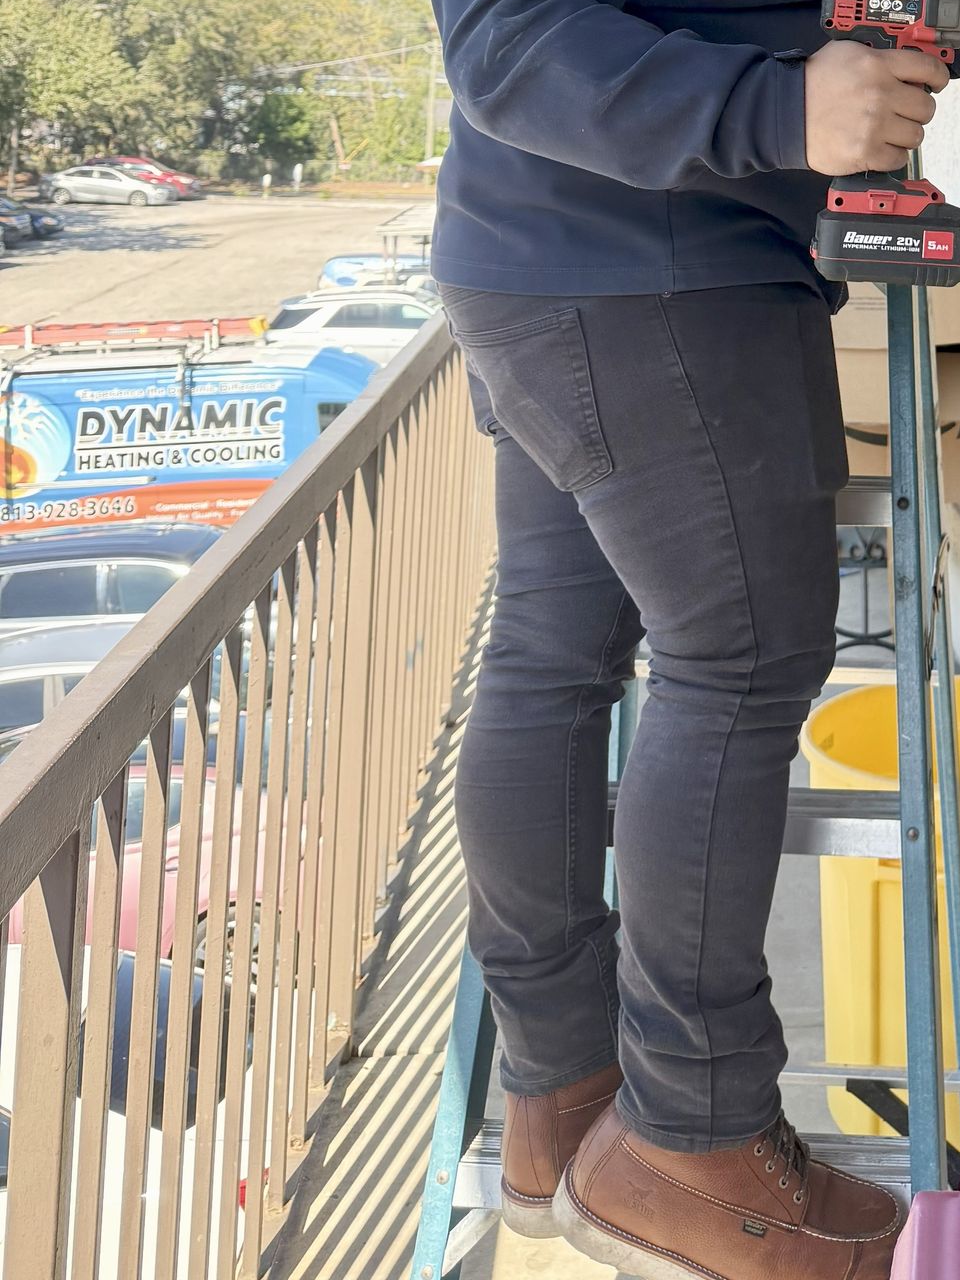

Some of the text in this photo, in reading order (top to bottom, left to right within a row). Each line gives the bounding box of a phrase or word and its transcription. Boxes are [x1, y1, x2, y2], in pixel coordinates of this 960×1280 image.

[843, 231, 920, 247] Bauer 20V
[927, 241, 949, 251] 5AH
[79, 400, 283, 442] DYNAMIC
[79, 444, 281, 470] HEATING & COOLING
